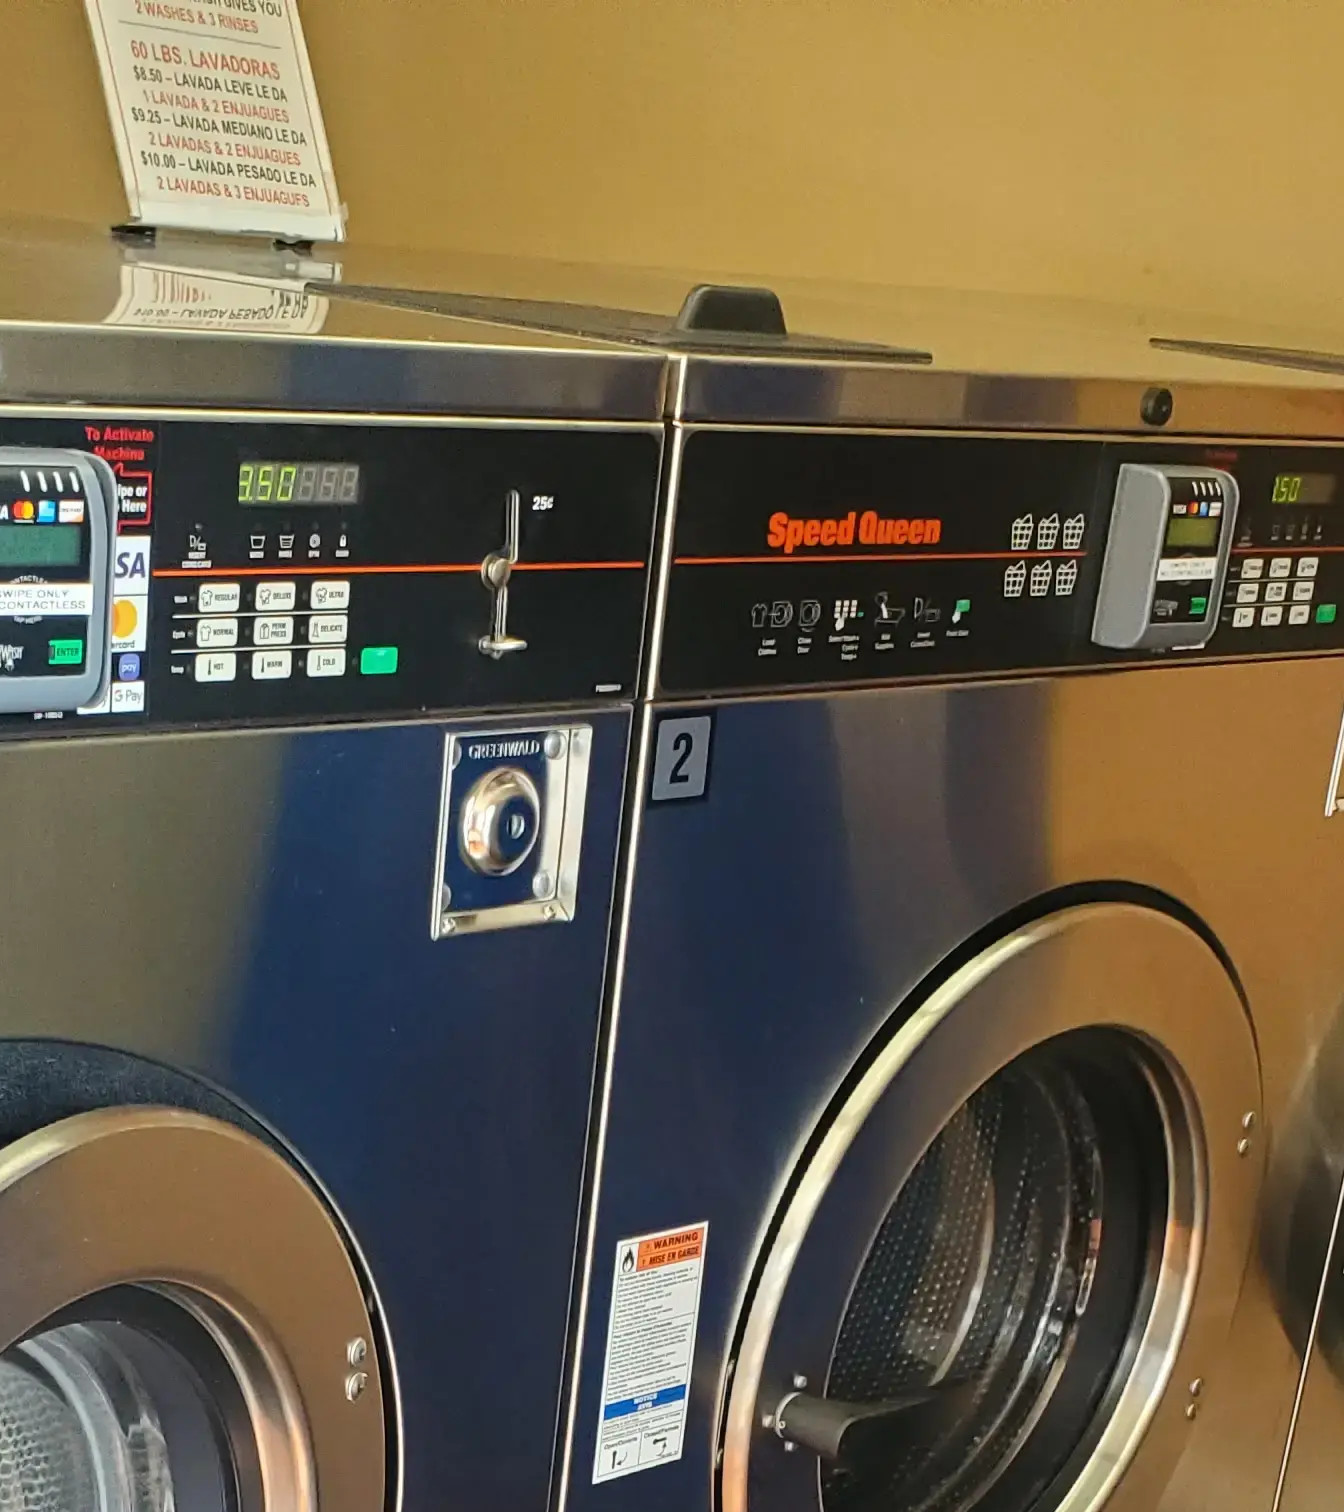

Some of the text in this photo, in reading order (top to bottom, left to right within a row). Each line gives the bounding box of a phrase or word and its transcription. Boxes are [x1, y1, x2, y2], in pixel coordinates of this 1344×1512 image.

[259, 0, 282, 17] YOU
[145, 2, 195, 24] WASHES
[197, 11, 206, 25] &
[209, 12, 215, 26] 3
[217, 14, 259, 33] RINSES
[131, 40, 280, 81] 60 LBS. LAVADORAS
[133, 65, 163, 83] $8.50
[174, 72, 222, 92] LAVADA
[224, 78, 253, 96] LEVE
[256, 83, 270, 99] LE
[272, 87, 288, 103] DA
[151, 91, 200, 110] LAVADA
[201, 98, 211, 112] &
[213, 99, 221, 112] 2
[223, 101, 290, 124] ENJUAGUES
[131, 107, 162, 124] $9.25
[172, 113, 218, 134] LAVADA
[221, 120, 273, 141] MEDIANO
[275, 127, 289, 143] LE
[291, 131, 307, 146] DA
[148, 131, 301, 167] 2 LAVADAS & 2 ENJUAGUES
[141, 151, 176, 169] $10.00
[187, 157, 235, 177] LAVADA
[237, 165, 282, 184] PESADO
[284, 172, 298, 185] LE
[300, 174, 317, 188] DA
[157, 176, 310, 208] 2 LAVADAS & 3 ENJUAGUES
[85, 426, 154, 442] To Activate
[135, 485, 147, 497] or
[122, 500, 147, 513] Here
[768, 510, 942, 554] Speed Queen
[116, 552, 146, 579] SA
[37, 589, 69, 599] ONLY
[214, 593, 238, 601] REGULAR
[272, 592, 292, 600] DELUXE
[328, 590, 344, 598] ULTRA
[212, 628, 234, 636] NORMAL
[320, 625, 343, 633] DELICATE
[56, 647, 79, 657] ENTER
[121, 662, 137, 673] pay
[266, 661, 283, 669] WARM
[322, 658, 336, 666] COLD
[126, 689, 142, 704] Pay
[469, 739, 540, 760] GREENWALD
[669, 732, 693, 784] 2
[653, 1231, 698, 1250] WARNING
[648, 1253, 665, 1265] MISE
